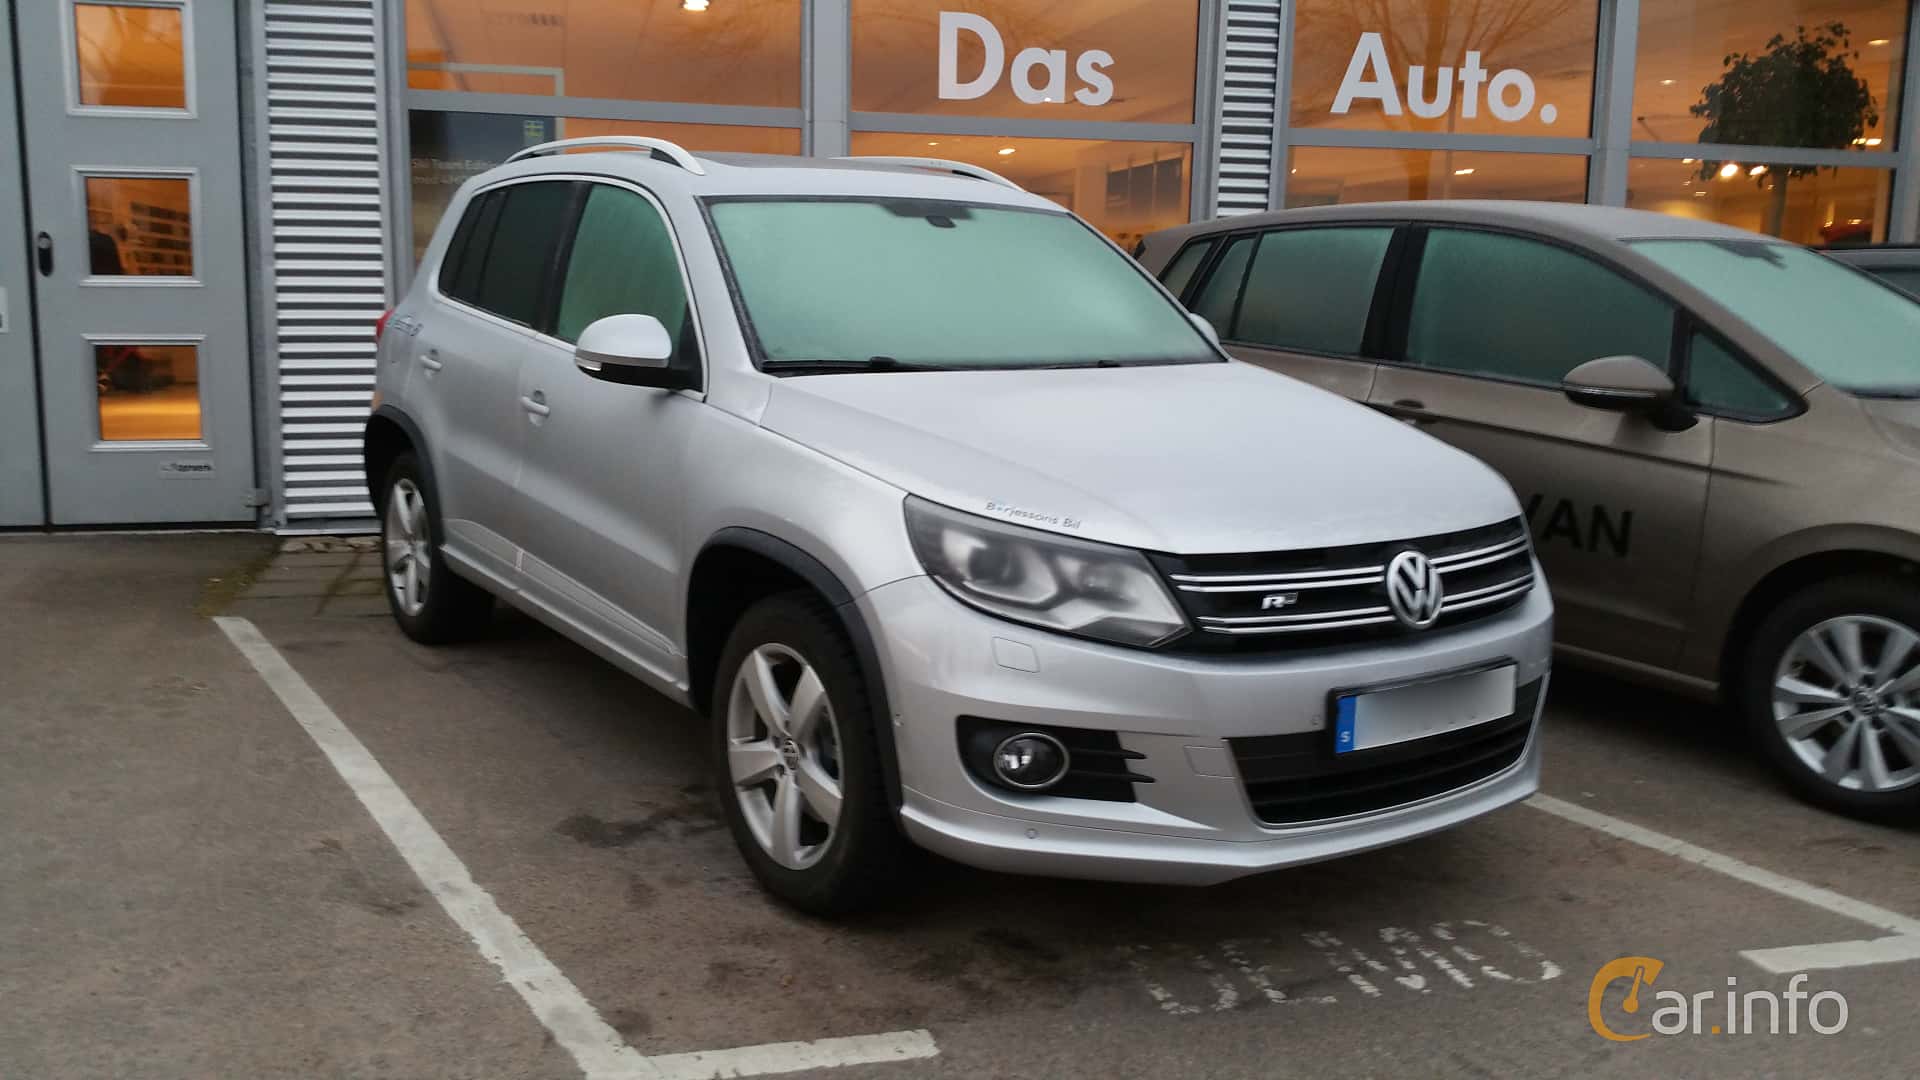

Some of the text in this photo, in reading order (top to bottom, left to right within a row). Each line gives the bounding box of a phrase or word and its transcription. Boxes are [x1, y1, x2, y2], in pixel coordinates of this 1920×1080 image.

[938, 11, 1558, 124] Das Auto.
[1062, 517, 1082, 530] Bil
[1340, 730, 1352, 744] S
